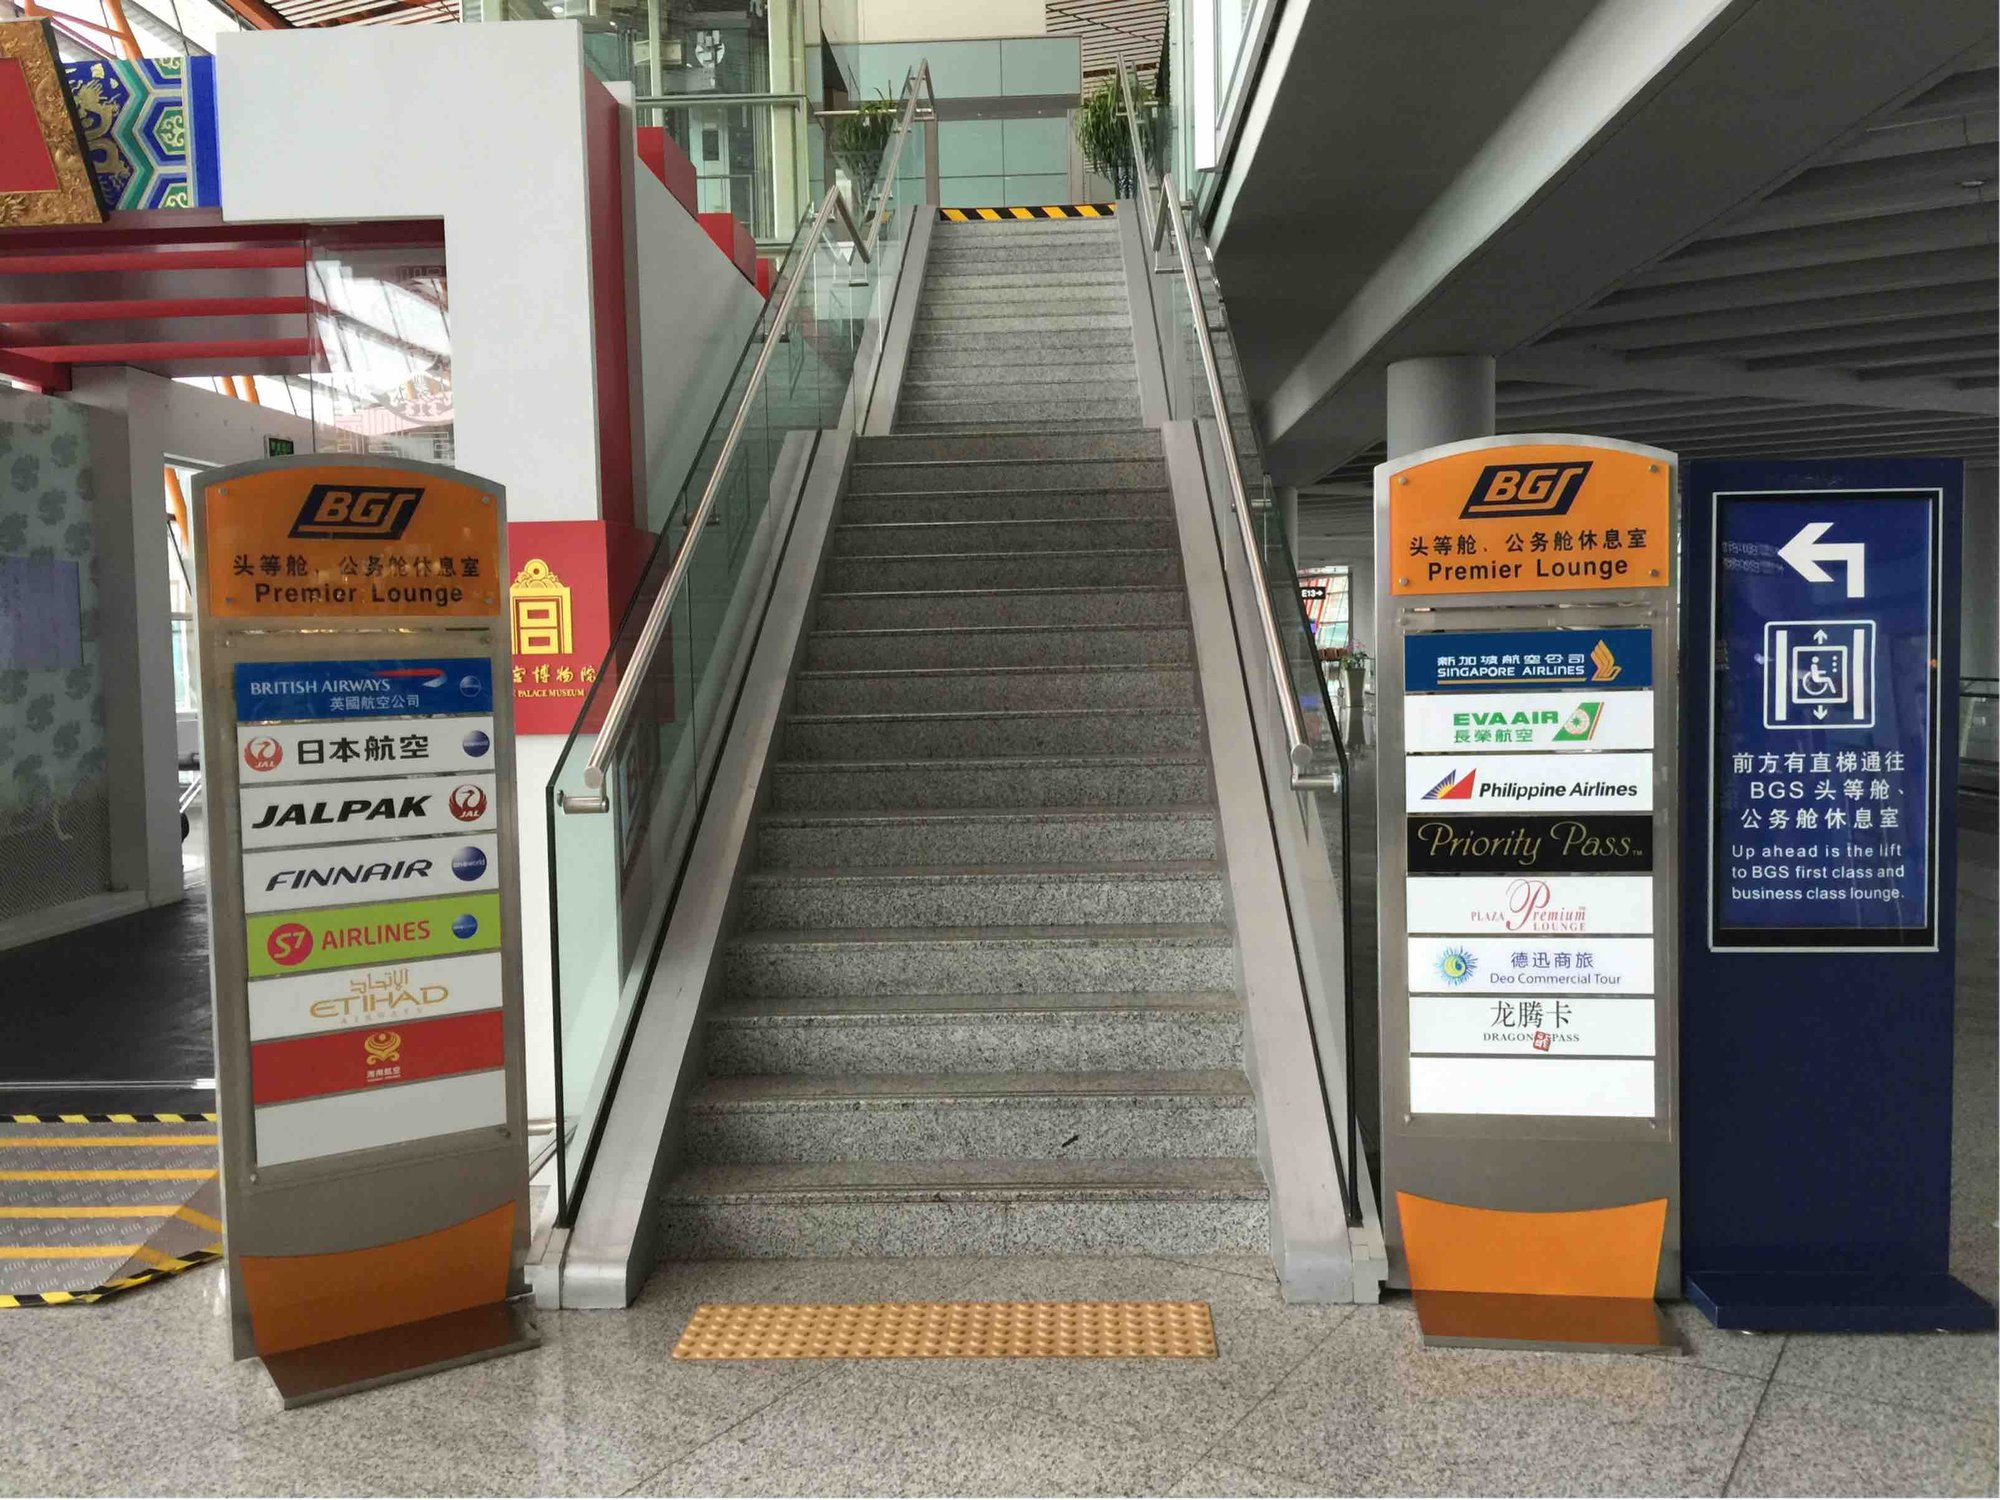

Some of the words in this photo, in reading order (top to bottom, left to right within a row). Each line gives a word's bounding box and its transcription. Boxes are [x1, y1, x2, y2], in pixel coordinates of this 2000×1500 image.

[1468, 467, 1584, 512] BGS
[299, 491, 415, 532] BGS
[1429, 561, 1522, 581] Premier
[1536, 559, 1628, 579] Lounge
[255, 583, 357, 603] Premier
[372, 583, 463, 606] Lounge
[1302, 589, 1315, 597] E13
[1437, 666, 1515, 678] SINGAPORE
[1522, 665, 1585, 676] AIRLINES
[250, 680, 317, 695] BRITISH
[321, 679, 390, 693] AIRWAYS
[518, 689, 548, 697] PALACE
[549, 689, 584, 697] MUSEUM
[329, 694, 419, 712] 英國航空公司
[1454, 728, 1533, 743] 長榮航空
[298, 734, 429, 765] 日本航空
[255, 760, 275, 768] JAL
[1732, 751, 1905, 774] 前方有直梯通往
[1479, 783, 1566, 800] Philippine
[1569, 782, 1638, 797] Airlines
[1750, 781, 1804, 799] BGS
[252, 795, 433, 829] JALPAK
[460, 810, 480, 818] JAL
[1741, 807, 1899, 830] 公务舱休息室
[1417, 822, 1542, 866] Priority
[1732, 845, 1755, 860] Up
[1762, 845, 1818, 857] ahead
[1825, 845, 1840, 857] is
[1847, 844, 1874, 857] the
[1879, 843, 1902, 857] lift
[265, 859, 433, 891] FINNAIR
[1732, 866, 1747, 879] to
[1752, 865, 1789, 879] BGS
[1795, 865, 1828, 879] first
[1832, 865, 1873, 879] class
[1877, 864, 1905, 878] and
[1732, 887, 1802, 900] business
[1806, 887, 1847, 900] class
[1850, 887, 1905, 902] lounge.
[1471, 912, 1505, 921] PLAZA
[1505, 879, 1586, 931] Premium
[1533, 922, 1586, 931] LOUNGE
[274, 931, 305, 958] S7
[321, 920, 430, 951] AIRLINES
[1511, 951, 1594, 969] 德迅商旅
[1490, 973, 1515, 984] Deo
[1518, 973, 1591, 984] Commercial
[1594, 973, 1622, 985] Tour
[310, 986, 448, 1018] ETIHAD
[1490, 1000, 1572, 1028] 龙腾卡
[1483, 1033, 1533, 1042] DRAGON
[1552, 1034, 1580, 1042] PASS
